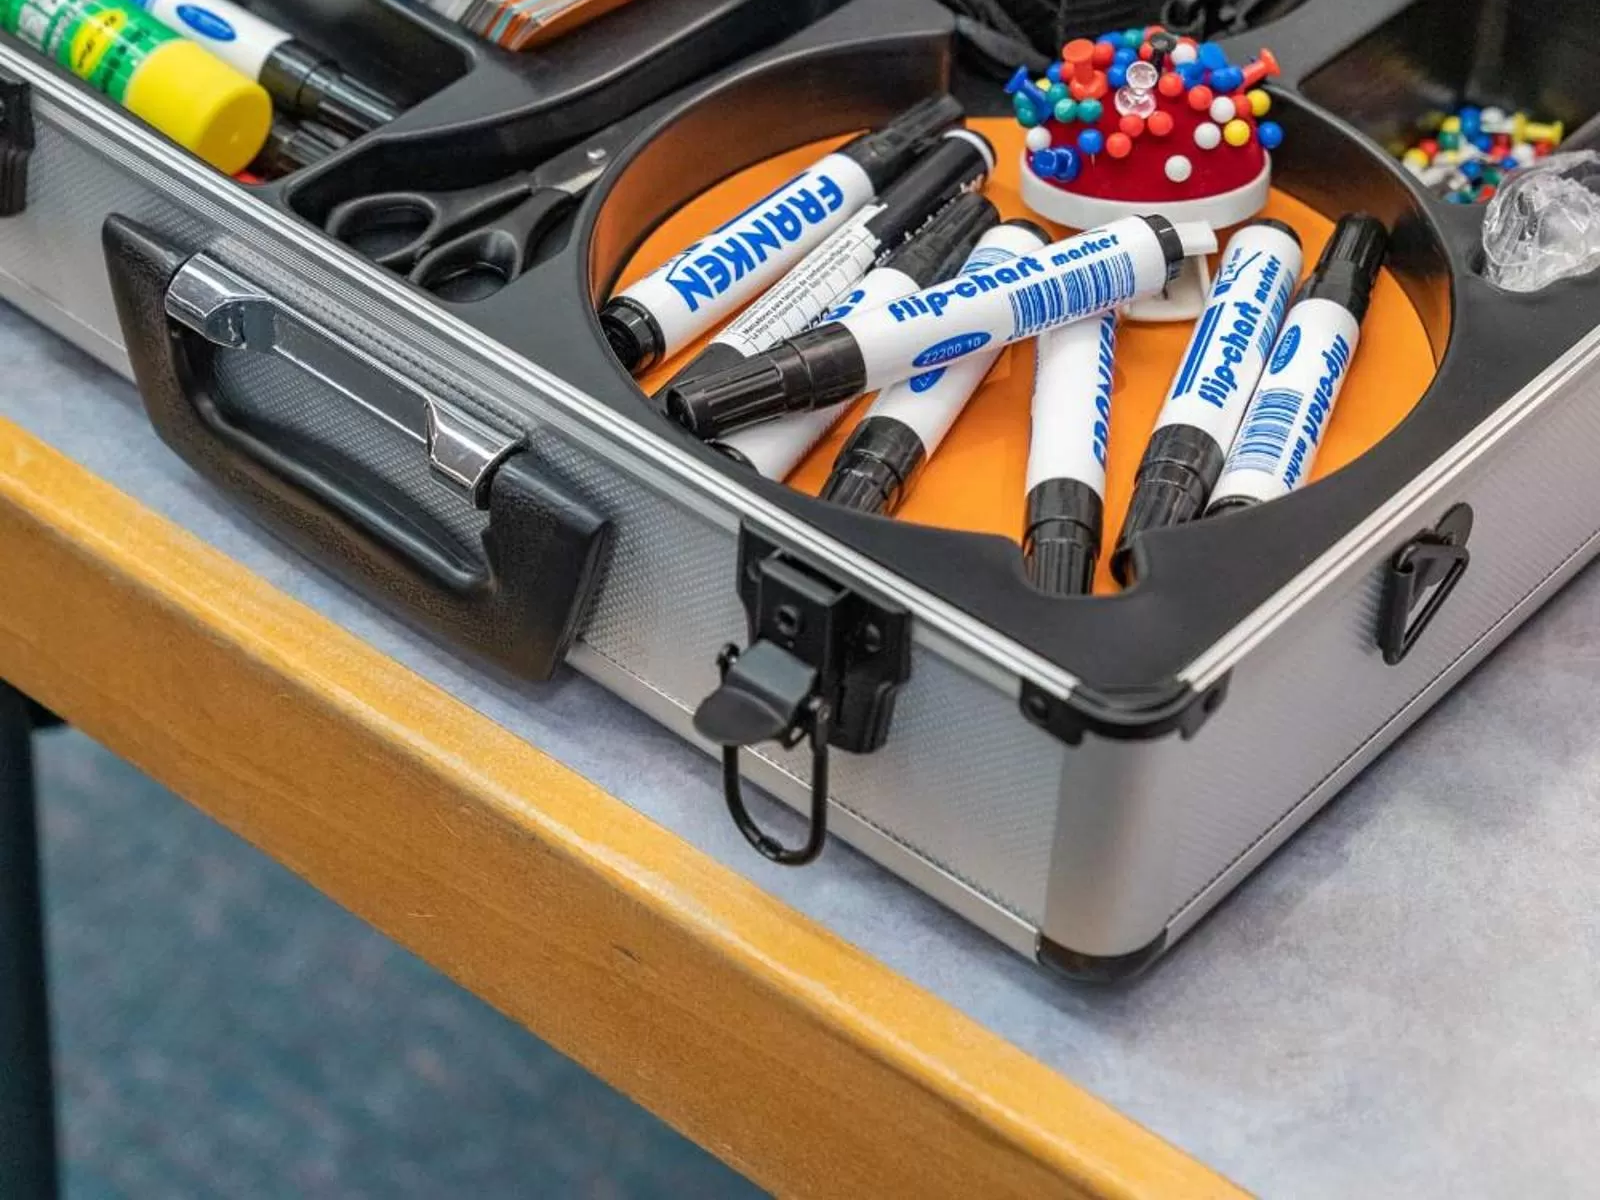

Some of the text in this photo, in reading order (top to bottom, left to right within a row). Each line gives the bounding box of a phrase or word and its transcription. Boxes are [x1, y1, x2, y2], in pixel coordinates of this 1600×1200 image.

[670, 174, 846, 313] FRANKEN
[887, 256, 1046, 323] flip-chart
[1050, 234, 1120, 267] marker
[1198, 301, 1262, 409] flip-chart
[1253, 255, 1282, 305] marker
[1283, 334, 1350, 490] flip-chart marker
